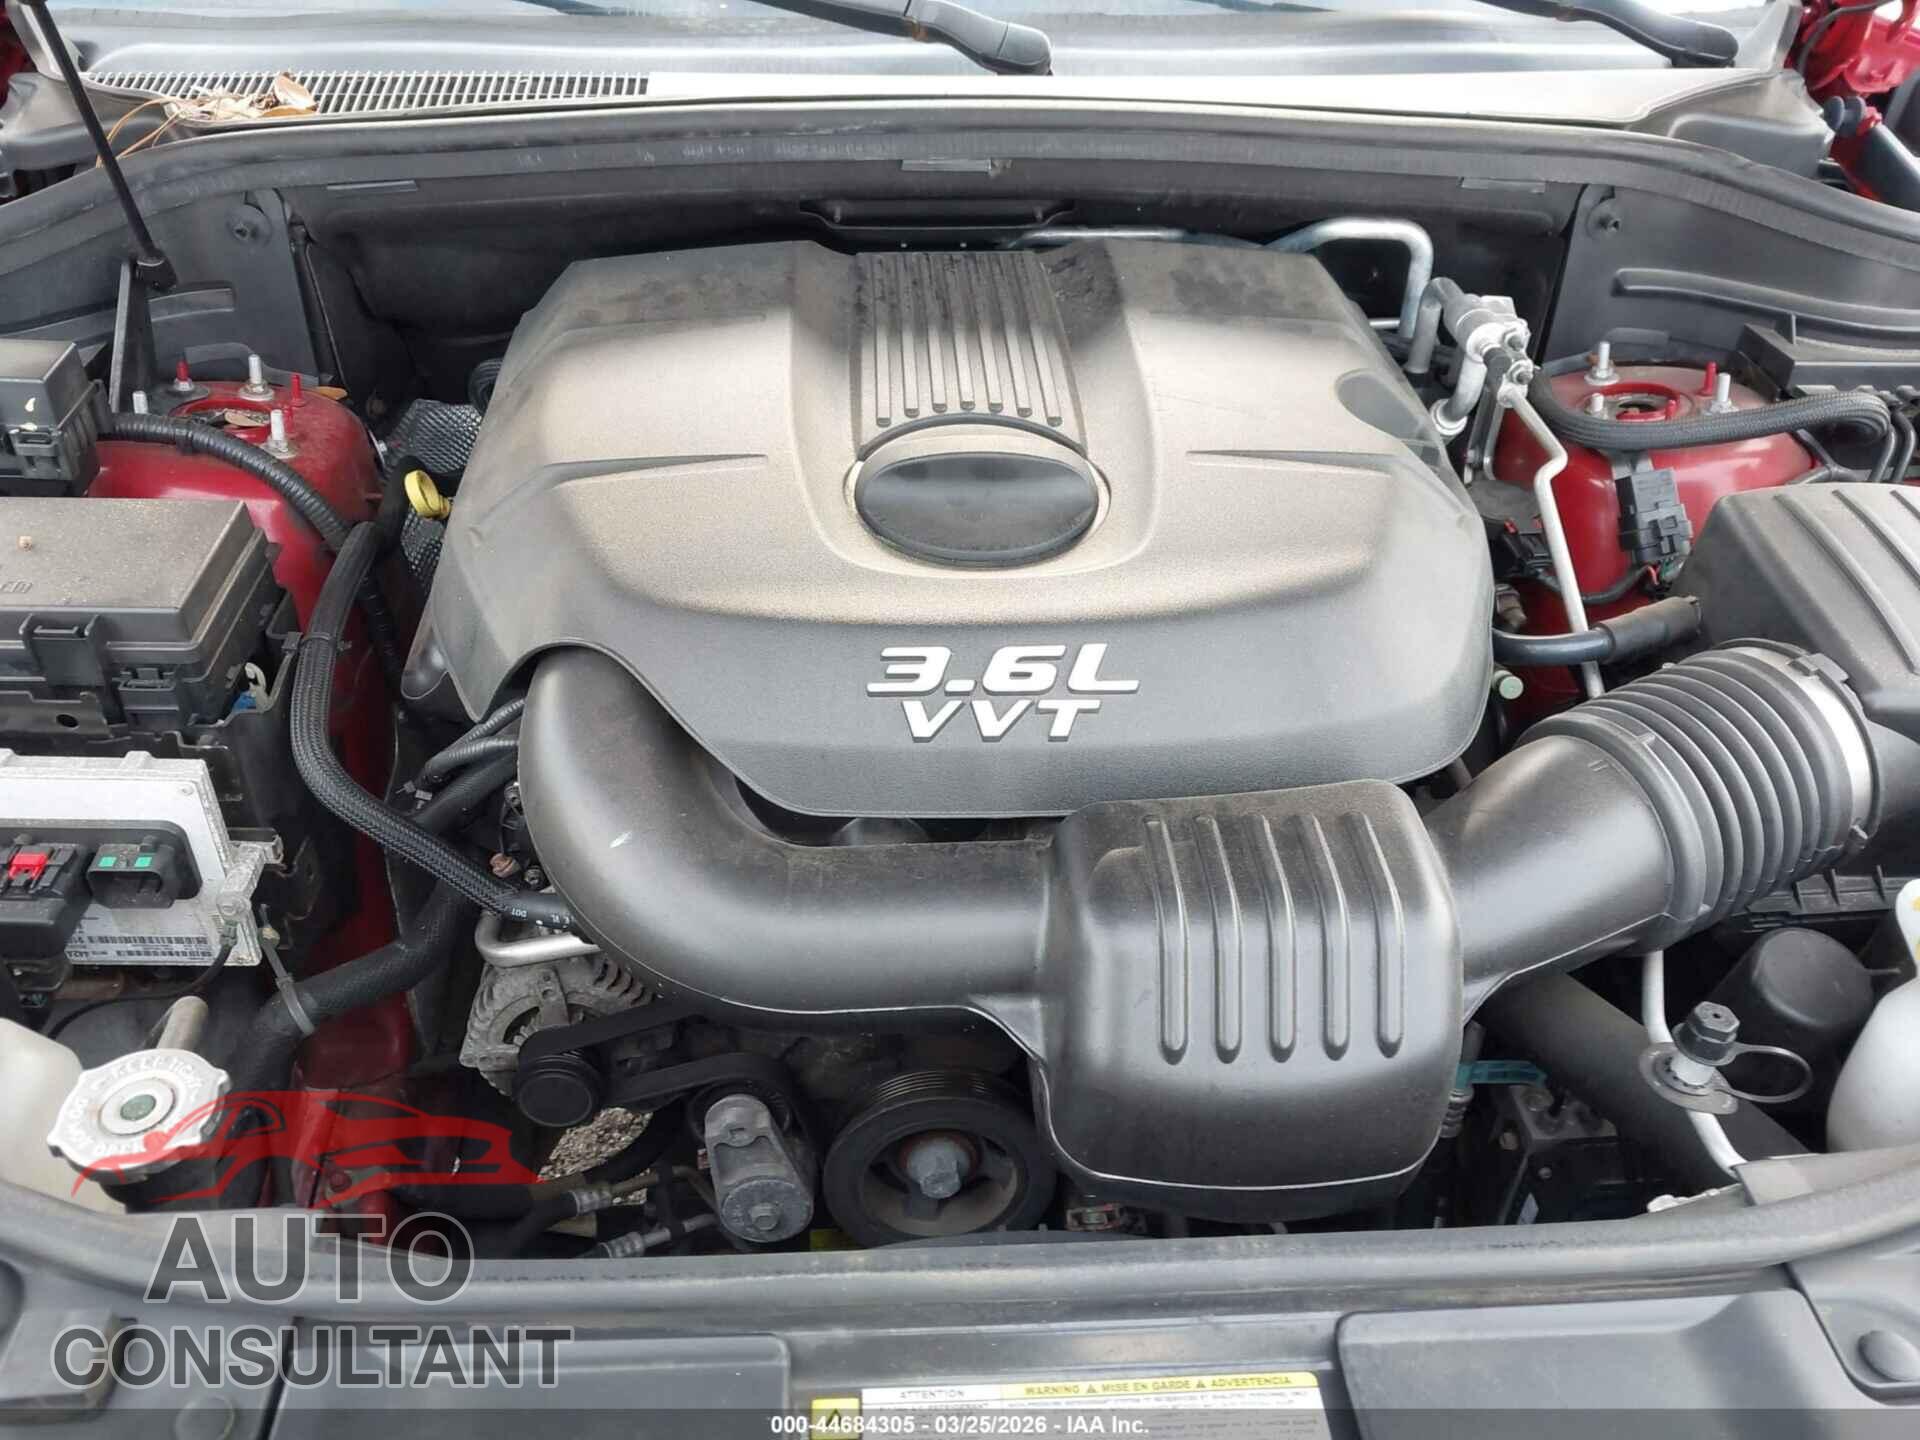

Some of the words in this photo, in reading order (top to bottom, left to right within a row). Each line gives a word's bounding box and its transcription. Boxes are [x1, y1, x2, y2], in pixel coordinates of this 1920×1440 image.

[866, 643, 1140, 696] 3.6L
[901, 699, 1101, 743] VVT
[899, 1389, 965, 1399] ATTENTION
[1025, 1384, 1080, 1396] WARNING
[1101, 1382, 1129, 1393] MISE
[1133, 1381, 1148, 1392] EN
[1152, 1379, 1192, 1391] GARDE
[1211, 1375, 1292, 1388] ADVERTENCIA
